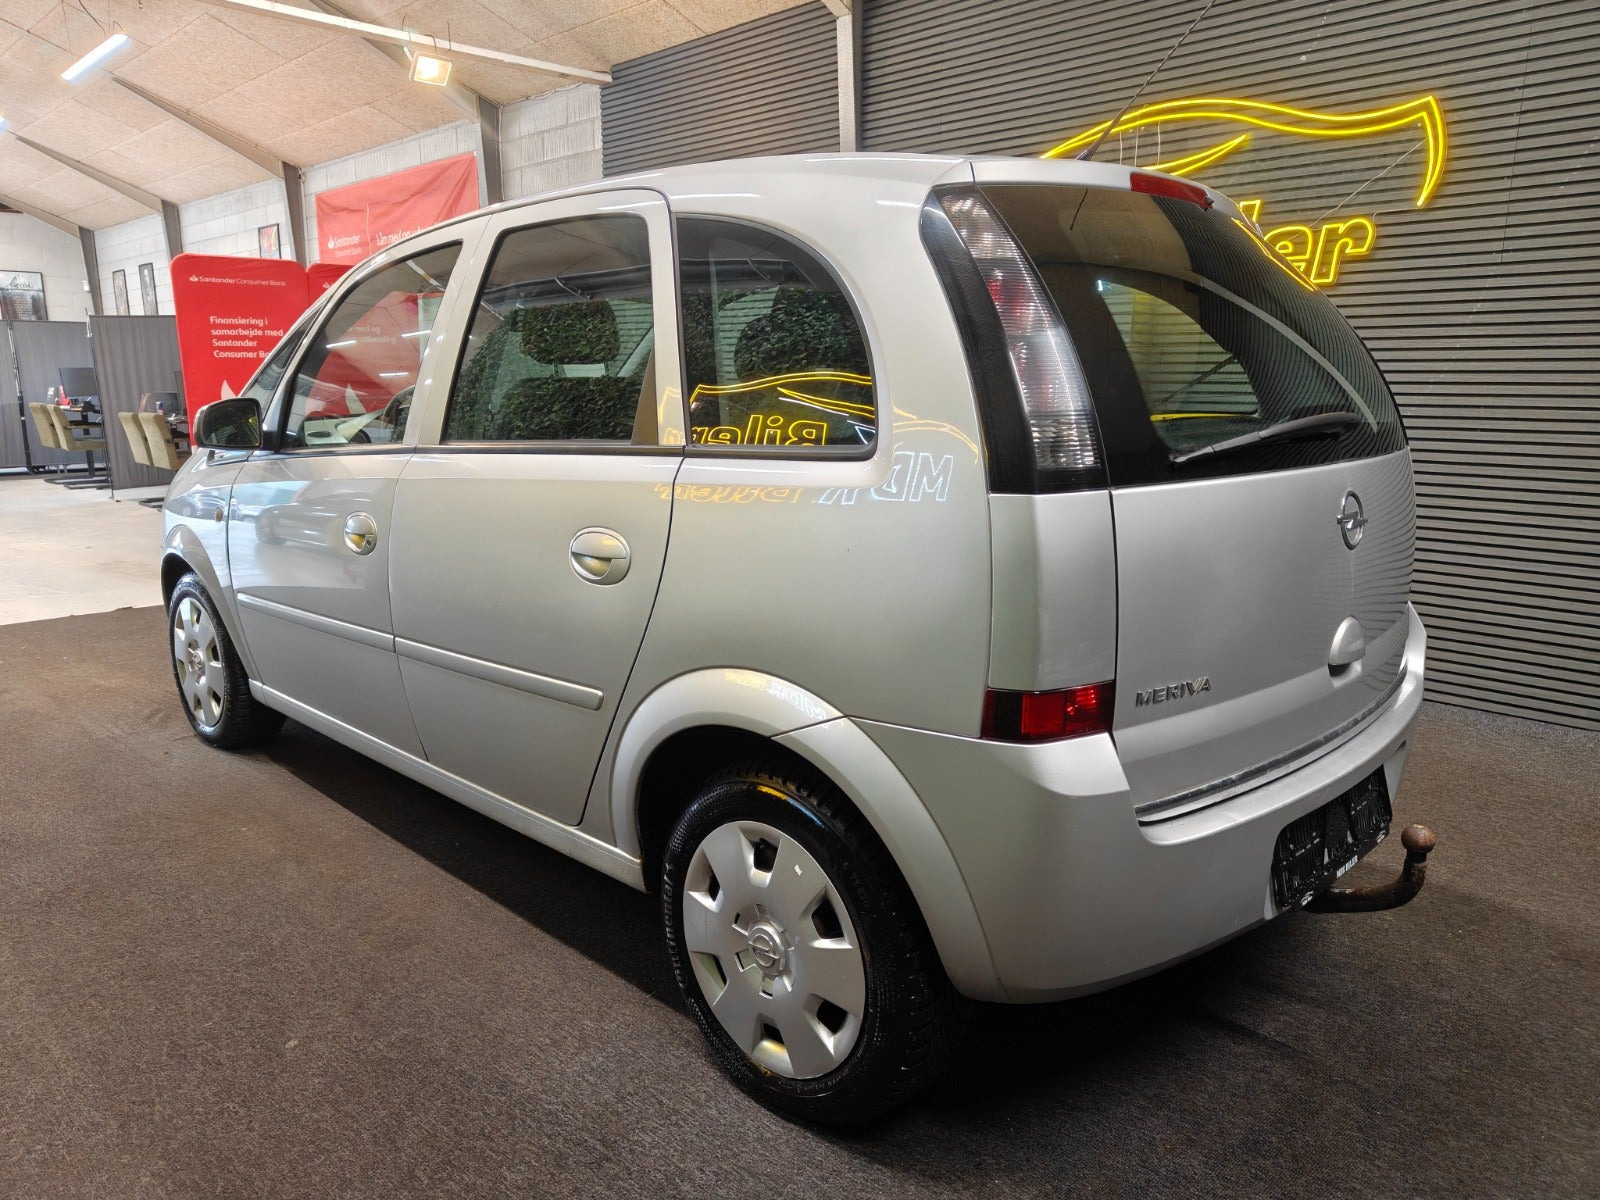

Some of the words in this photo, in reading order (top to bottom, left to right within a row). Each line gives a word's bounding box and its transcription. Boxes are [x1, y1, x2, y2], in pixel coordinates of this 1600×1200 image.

[199, 276, 235, 284] Santander
[209, 316, 263, 327] Finansiering
[264, 317, 268, 325] i
[211, 328, 263, 338] samarbejde
[264, 329, 284, 337] med
[212, 338, 257, 347] Santander
[213, 350, 257, 358] Consumer
[1135, 676, 1211, 708] MERIVA
